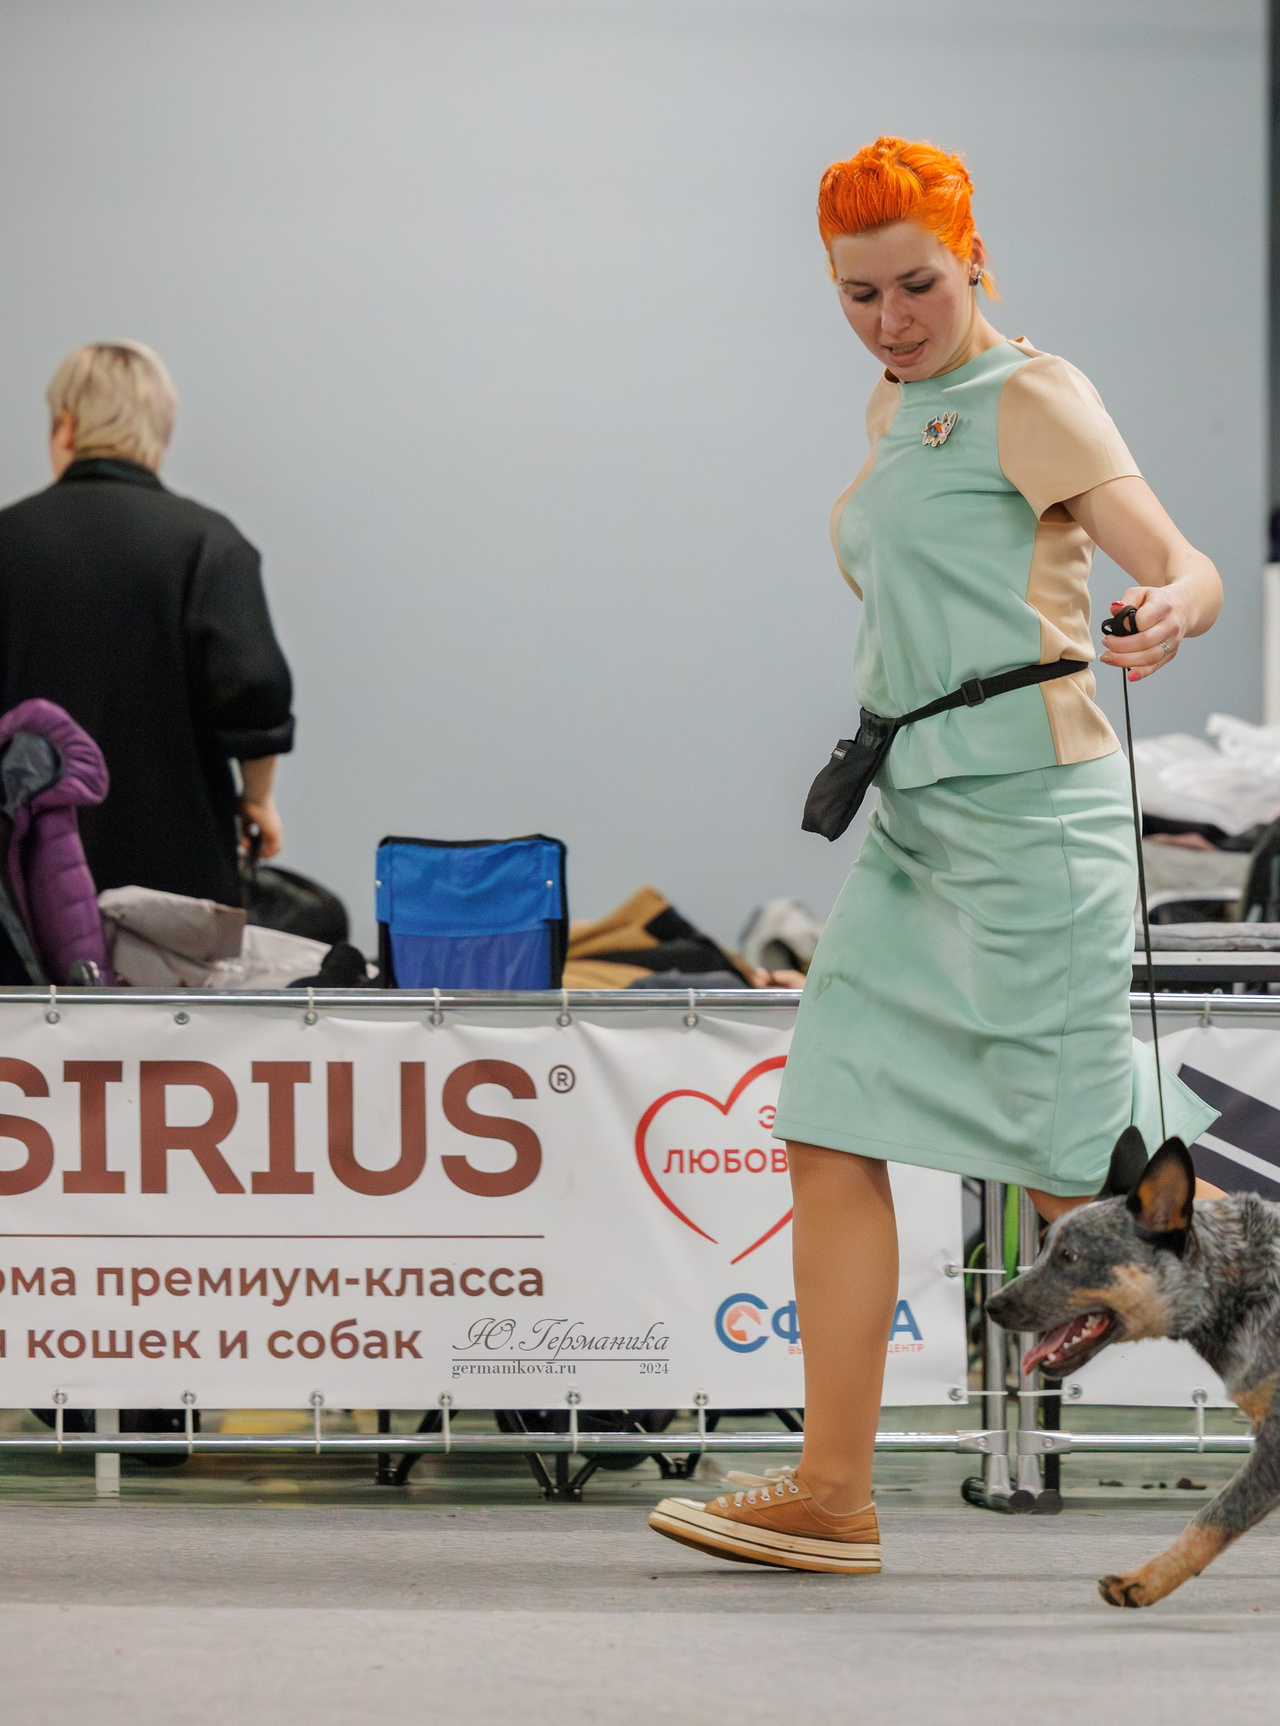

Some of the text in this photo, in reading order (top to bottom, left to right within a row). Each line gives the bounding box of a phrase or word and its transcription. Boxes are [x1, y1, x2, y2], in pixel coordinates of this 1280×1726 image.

[663, 1148, 789, 1174] ЛЮБОВ
[96, 1266, 544, 1307] премиум-класса
[27, 1329, 201, 1359] кошек
[219, 1329, 249, 1359] и
[266, 1317, 423, 1359] собак
